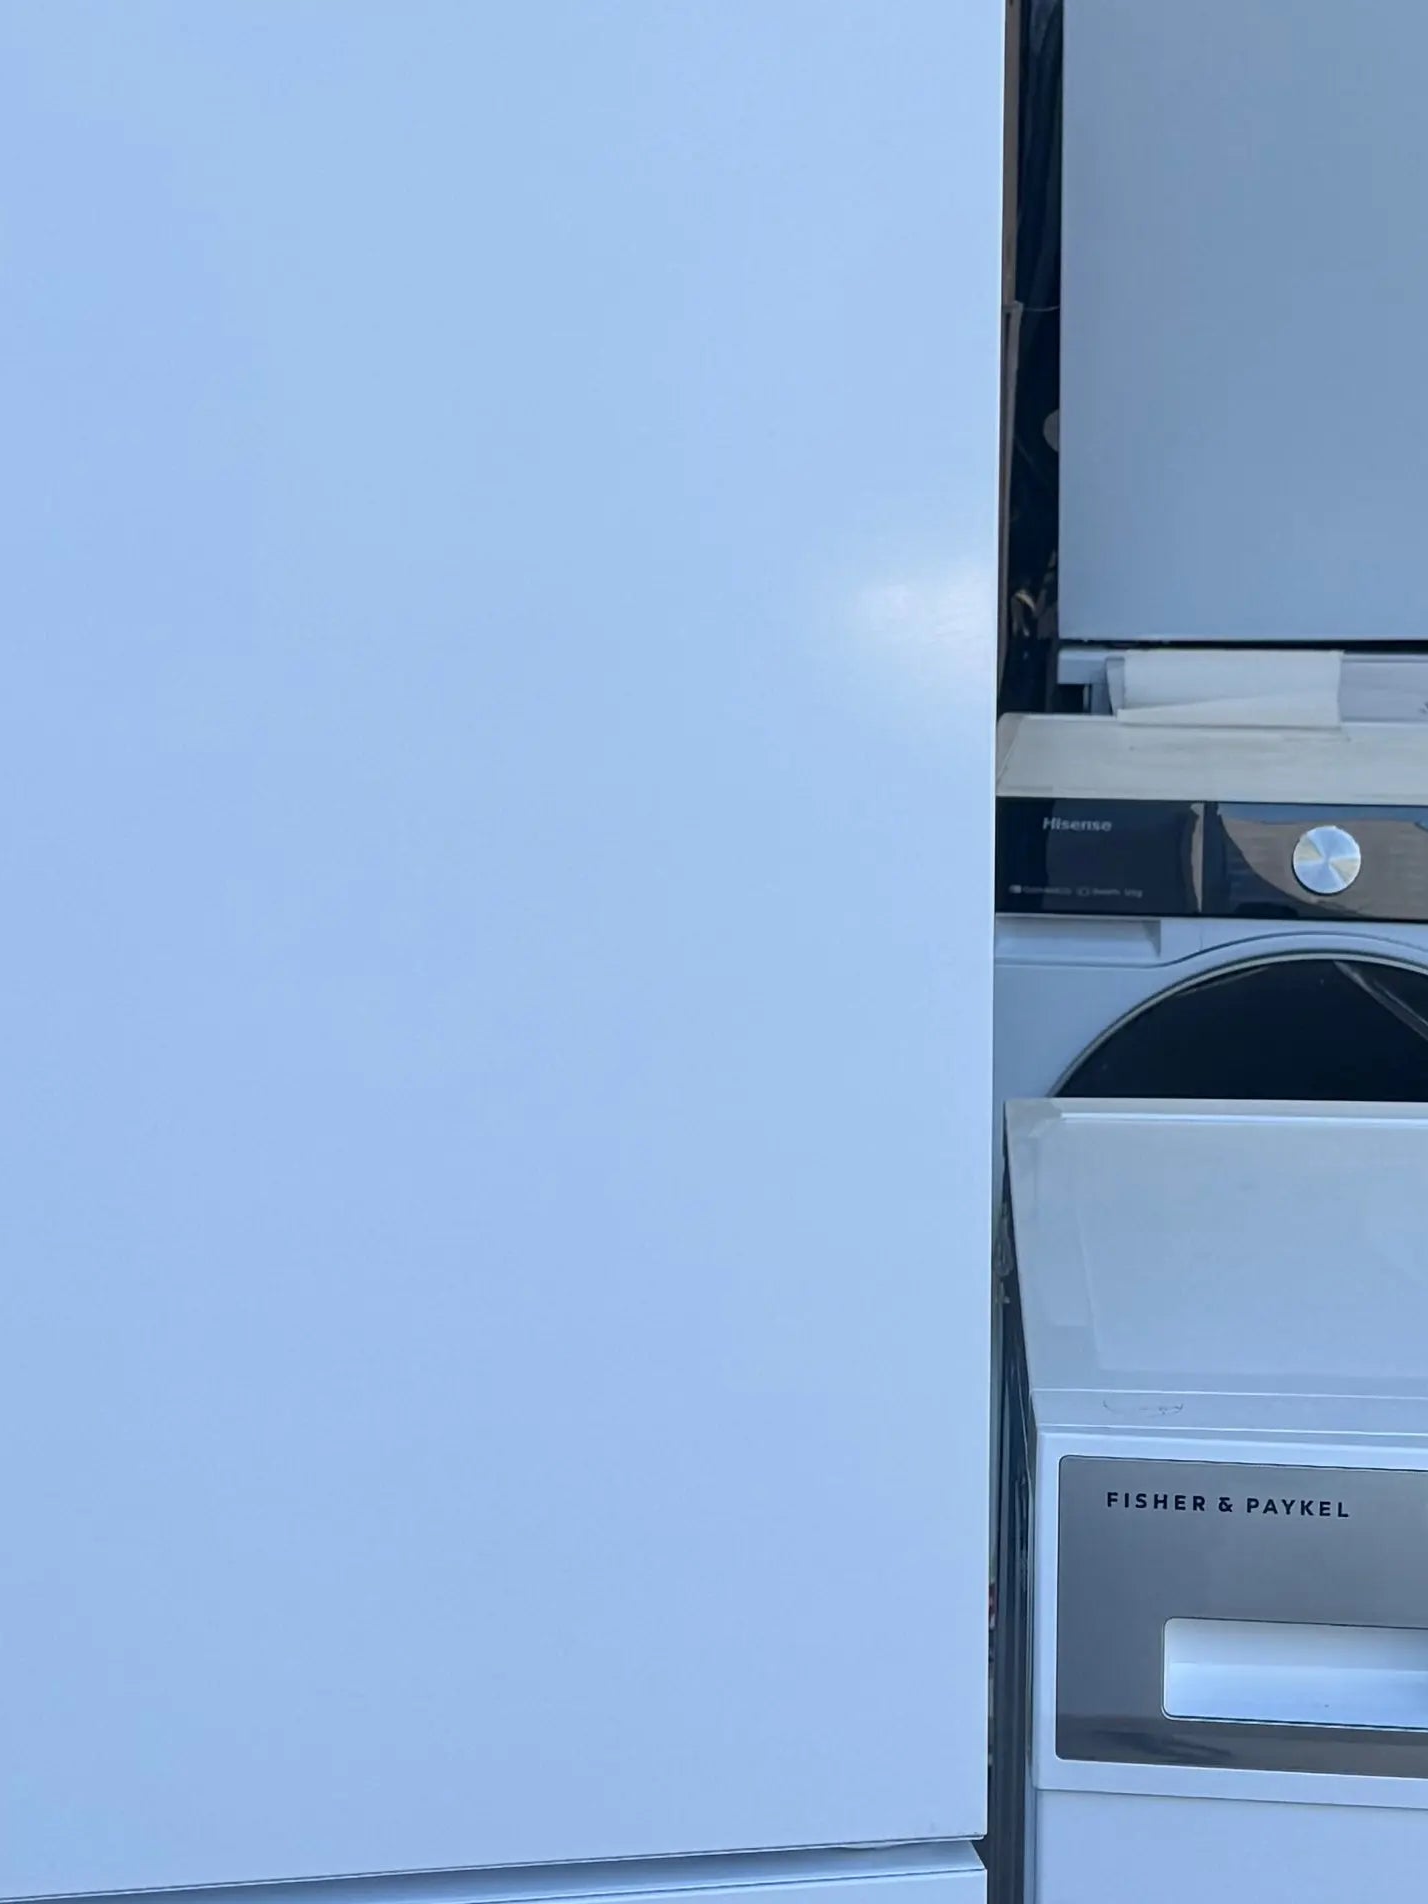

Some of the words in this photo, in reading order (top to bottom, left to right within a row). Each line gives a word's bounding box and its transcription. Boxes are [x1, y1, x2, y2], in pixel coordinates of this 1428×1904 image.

[1043, 817, 1112, 832] Hisense
[1107, 1492, 1205, 1511] FISHER
[1218, 1497, 1233, 1512] &
[1246, 1498, 1349, 1518] PAYKEL
